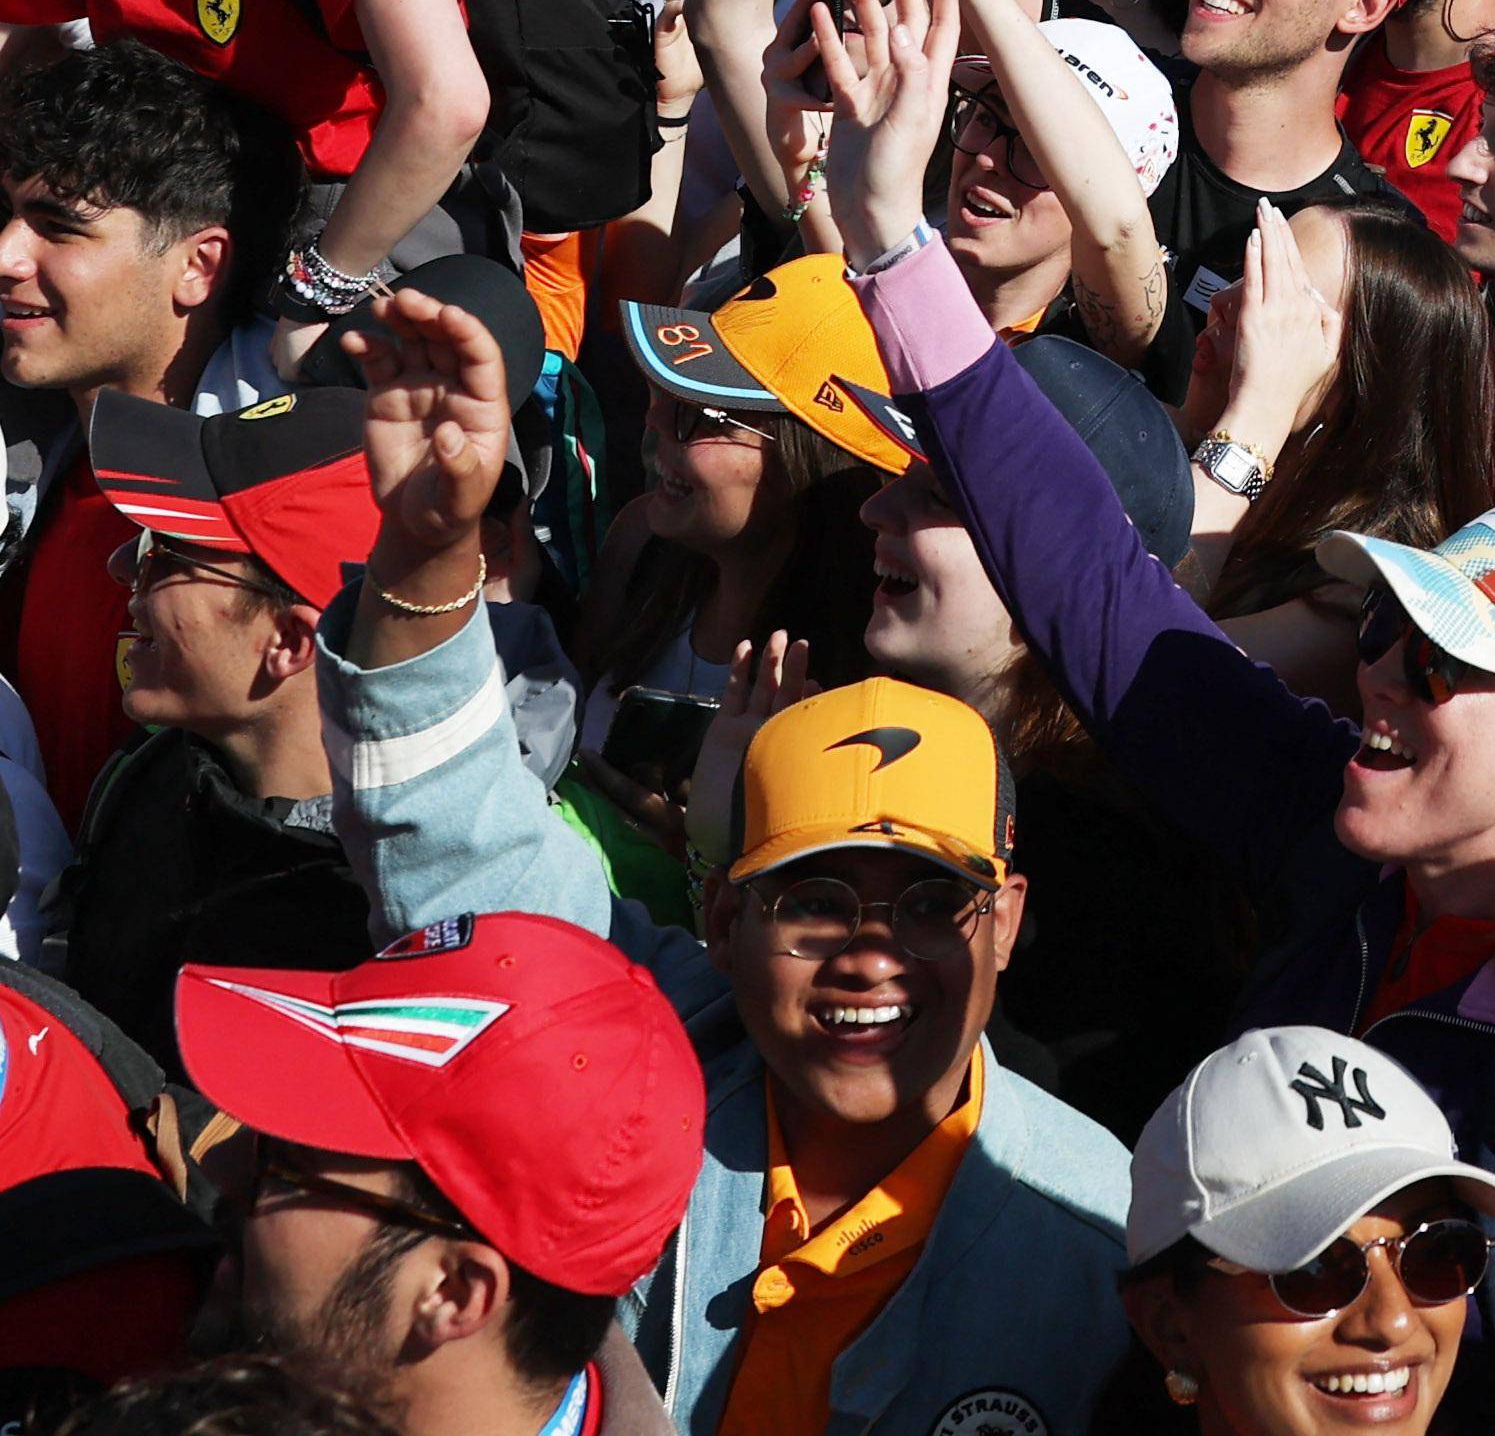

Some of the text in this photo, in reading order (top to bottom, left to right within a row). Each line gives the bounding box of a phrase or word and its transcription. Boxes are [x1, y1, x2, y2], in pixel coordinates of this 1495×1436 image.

[1056, 48, 1115, 98] aren
[1290, 1056, 1386, 1132] NY
[848, 1232, 884, 1257] CISCO
[953, 1397, 1039, 1433] STRAUSS
